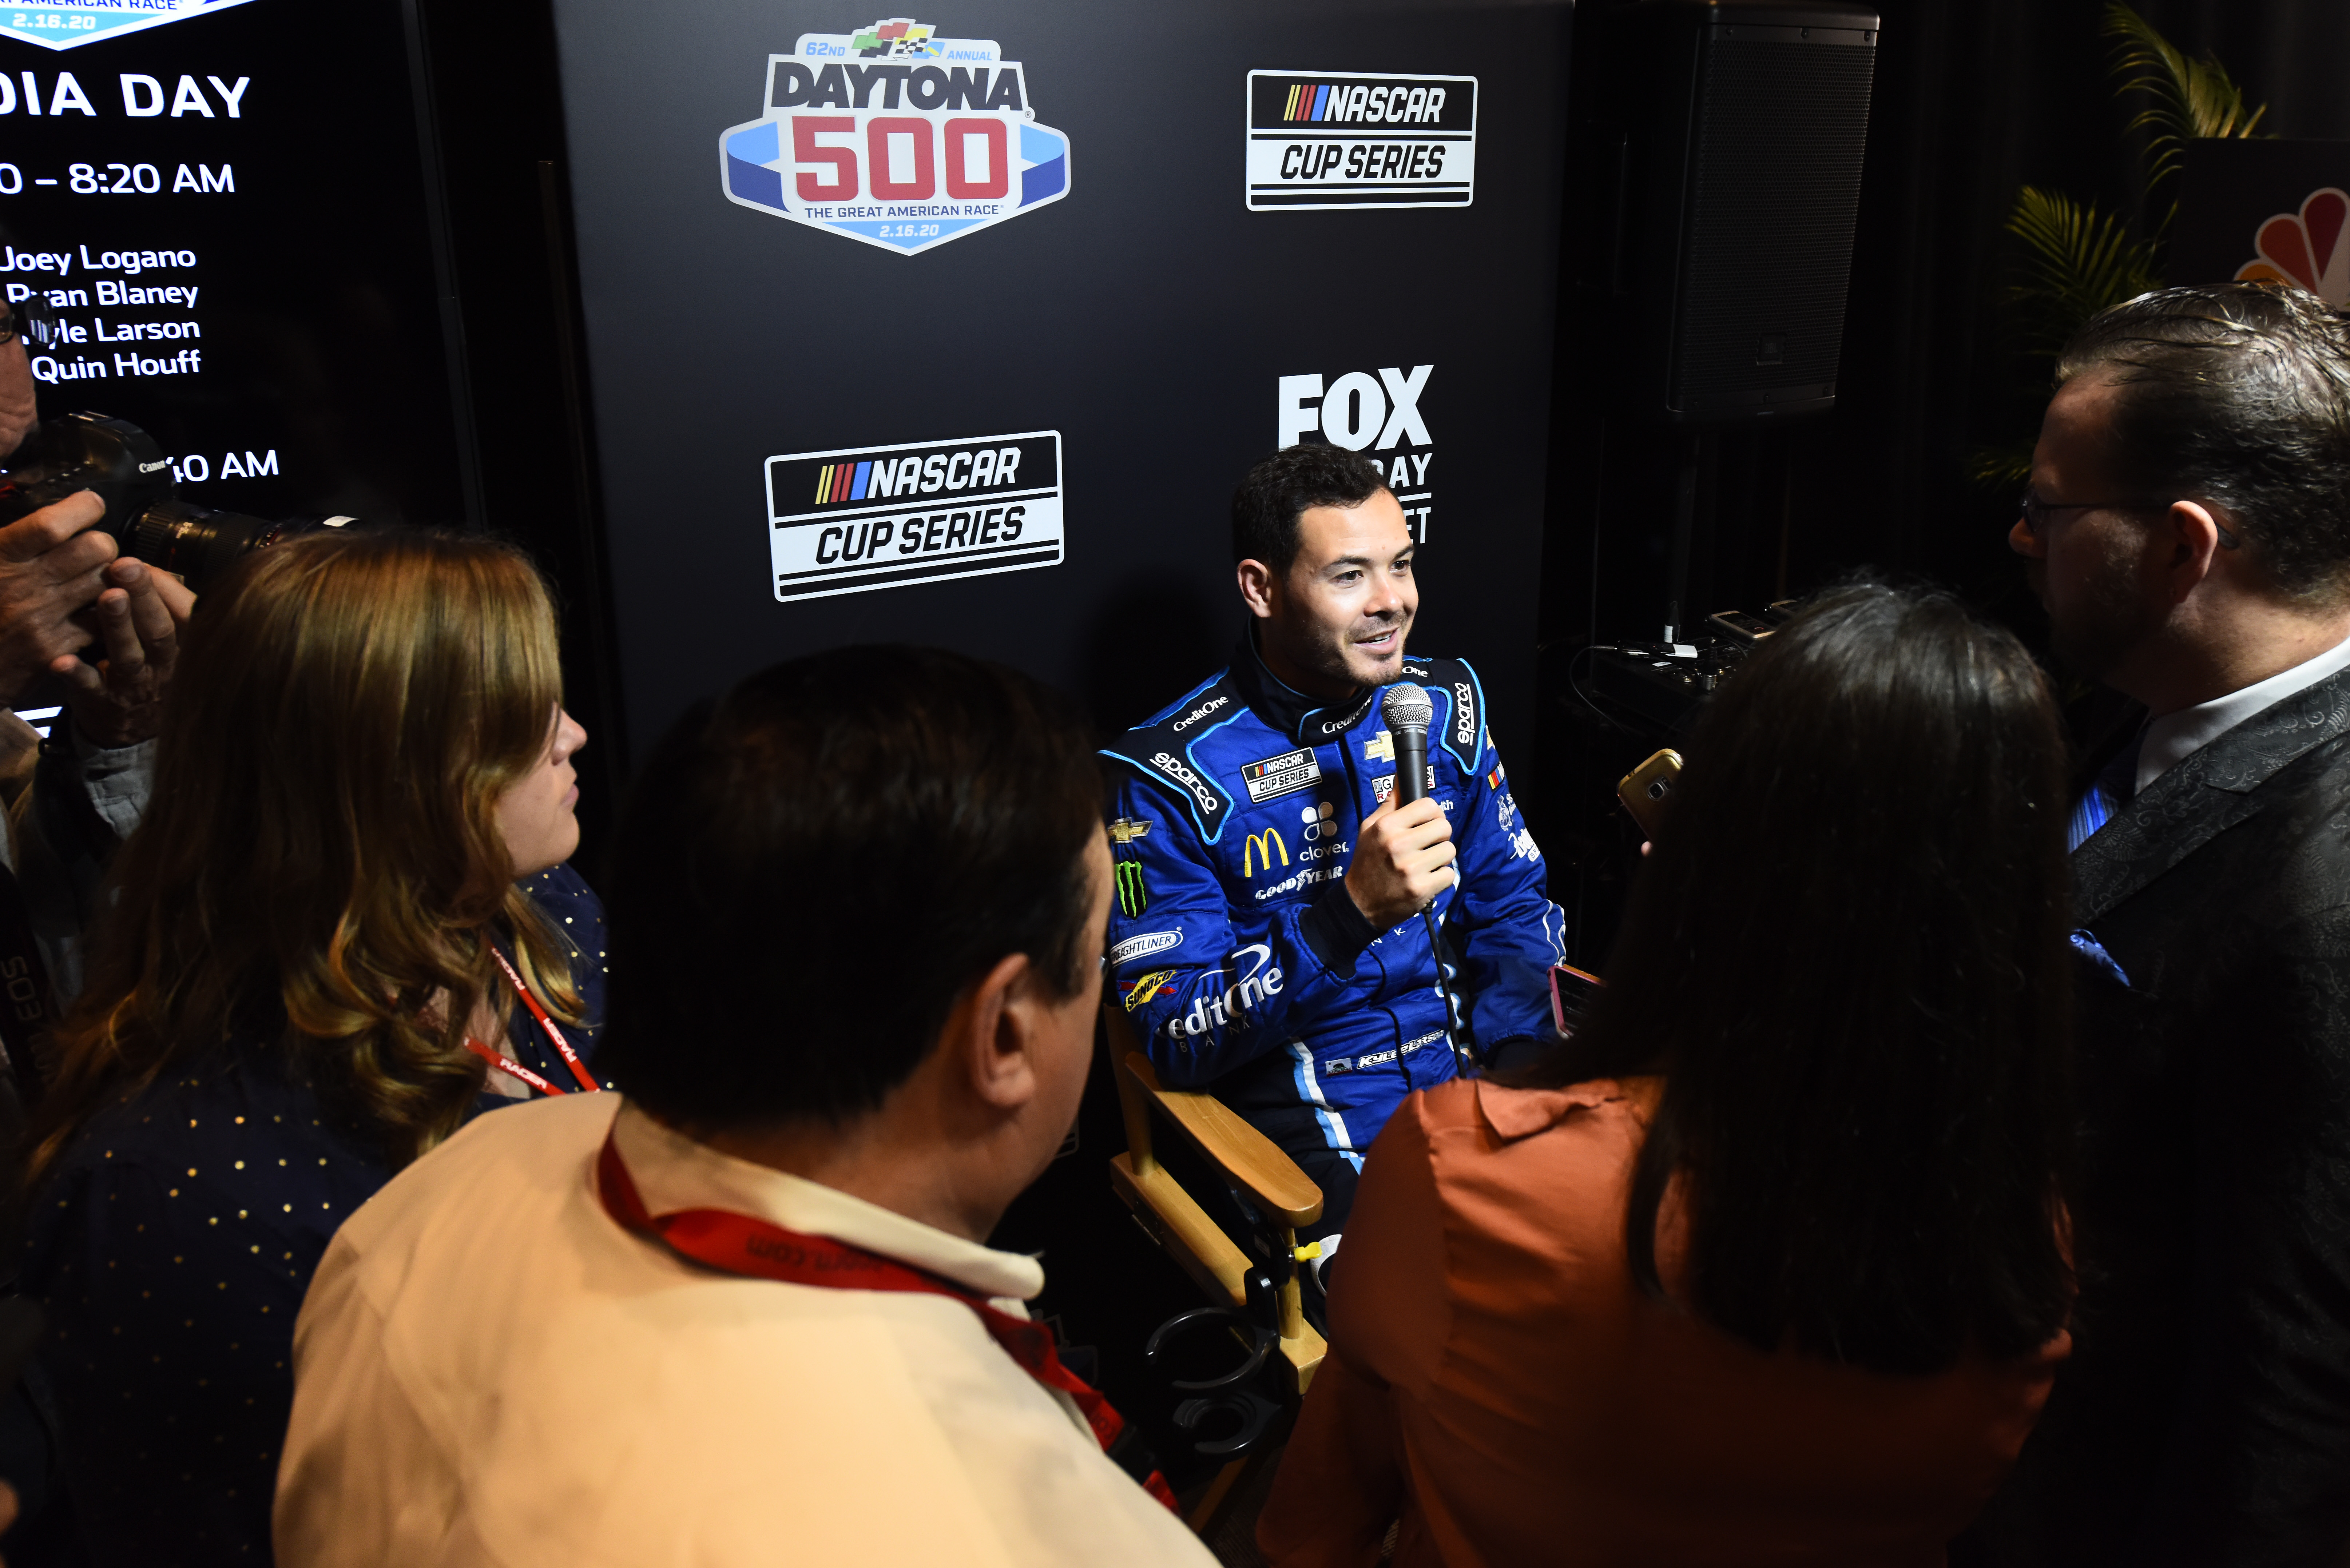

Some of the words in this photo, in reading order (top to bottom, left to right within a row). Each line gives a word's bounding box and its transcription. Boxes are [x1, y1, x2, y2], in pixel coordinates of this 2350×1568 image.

[12, 13, 96, 30] 2.16.20
[806, 42, 845, 56] 62ND
[947, 50, 993, 61] ANNUAL
[120, 74, 250, 118] DAY
[771, 62, 1023, 111] DAYTONA
[1324, 85, 1446, 123] NASCAR
[792, 116, 1009, 202] 500
[1280, 145, 1343, 179] CUP
[1345, 145, 1446, 179] SERIES
[69, 163, 160, 194] 8:20
[172, 164, 235, 193] AM
[805, 207, 833, 218] THE
[838, 207, 883, 218] GREAT
[887, 206, 960, 217] AMERICAN
[964, 204, 999, 215] RACE
[879, 224, 939, 237] 2.16.20
[0, 246, 71, 276] Joey
[80, 245, 196, 274] Logano
[95, 280, 198, 308] Blaney
[95, 318, 201, 342] Larson
[31, 356, 107, 384] Quin
[114, 349, 201, 377] Houff
[1278, 365, 1434, 451] FOX
[139, 460, 166, 473] Canon
[221, 449, 279, 479] AM
[867, 447, 1021, 499] NASCAR
[815, 521, 894, 565] CUP
[898, 505, 1026, 554] SERIES
[1173, 696, 1229, 732] CreditOne
[1454, 682, 1475, 746] sparco
[1266, 753, 1304, 774] NASCAR
[1149, 752, 1218, 815] sparco
[1259, 778, 1277, 792] CUP
[1279, 768, 1309, 786] SERIES
[1127, 969, 1174, 1010] SUNOCO
